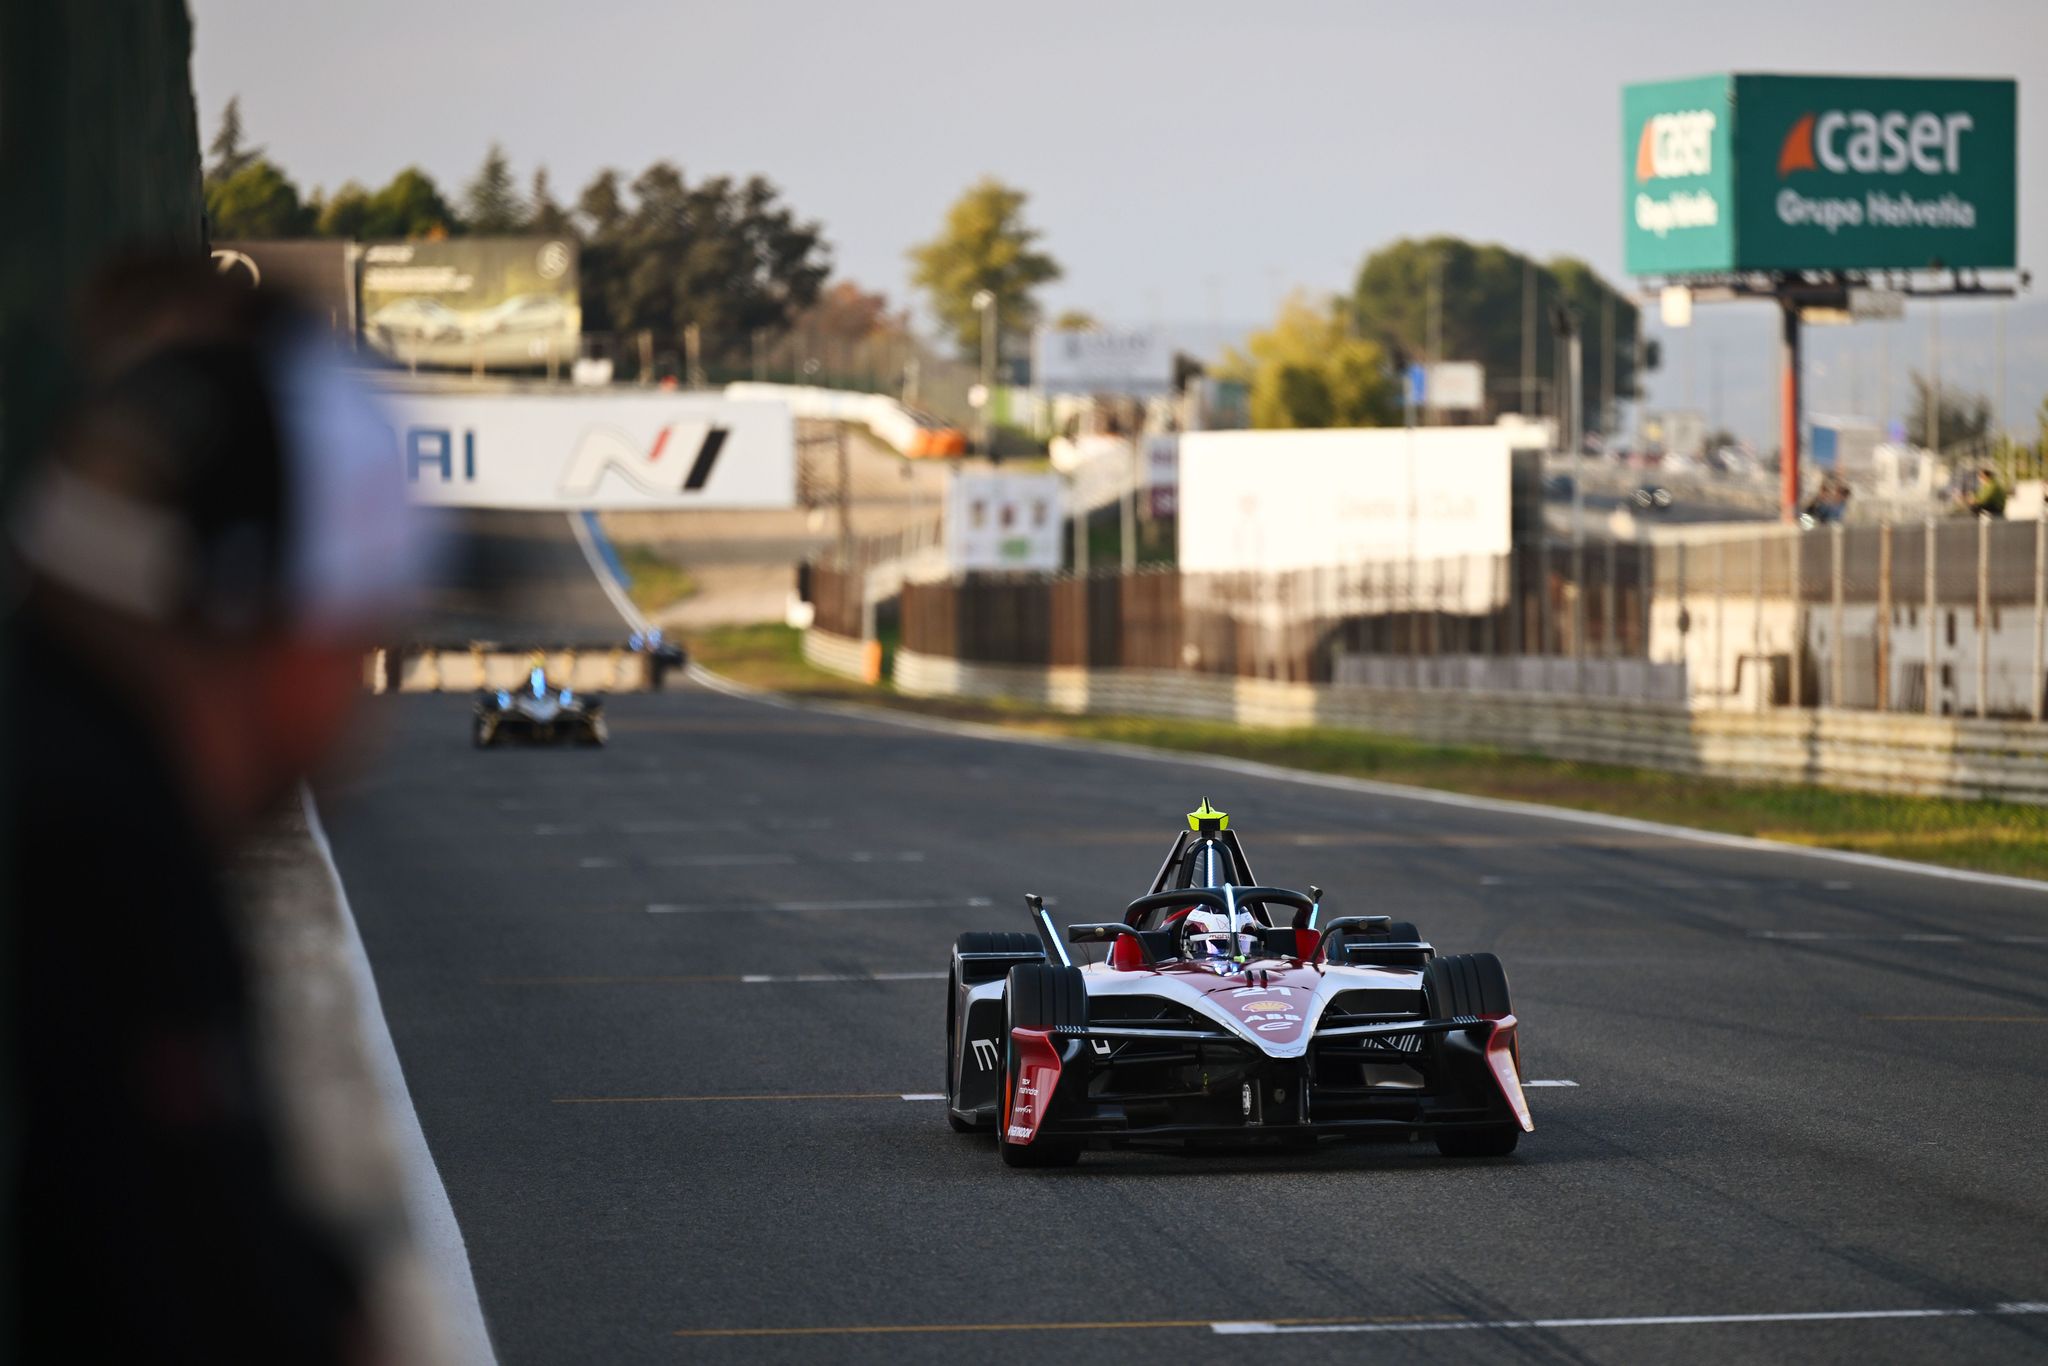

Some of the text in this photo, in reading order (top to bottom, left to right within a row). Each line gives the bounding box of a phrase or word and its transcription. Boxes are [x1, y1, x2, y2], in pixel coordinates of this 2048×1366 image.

[1817, 111, 1973, 174] caser
[1776, 188, 1864, 234] Grupo
[1244, 1013, 1302, 1023] ABB
